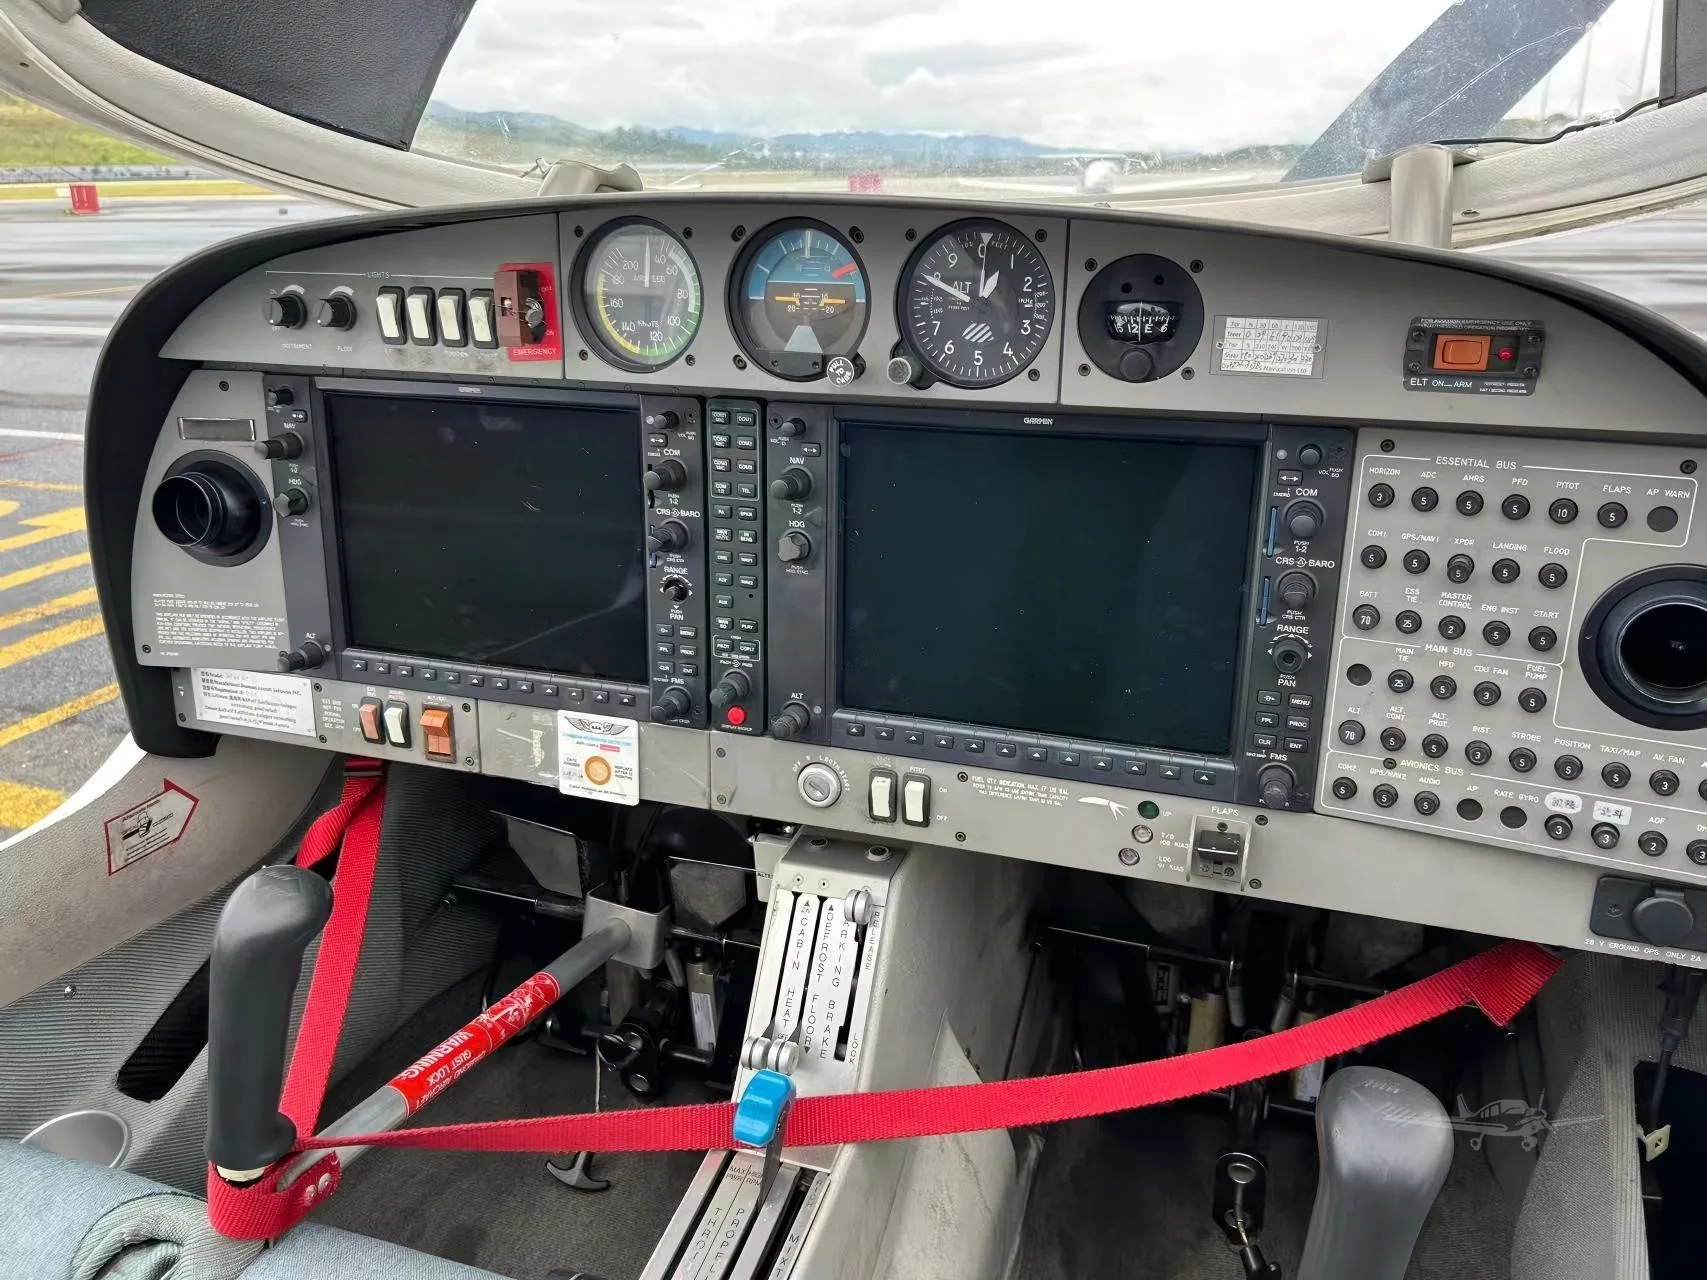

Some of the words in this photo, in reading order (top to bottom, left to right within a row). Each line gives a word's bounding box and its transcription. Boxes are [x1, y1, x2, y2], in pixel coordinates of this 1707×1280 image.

[655, 255, 666, 264] 40
[949, 253, 957, 268] 9
[1010, 254, 1014, 269] 1
[623, 260, 638, 270] 200
[952, 282, 972, 293] ALT
[1023, 276, 1032, 292] 2
[677, 289, 688, 299] 80
[610, 298, 624, 308] 160
[667, 316, 680, 326] 100
[622, 322, 635, 331] 140
[932, 321, 940, 335] 7
[1021, 320, 1031, 335] 3
[1128, 323, 1139, 333] 12
[1145, 324, 1152, 333] E
[650, 331, 663, 341] 120
[945, 340, 954, 354] 6
[1003, 341, 1013, 356] 4
[512, 348, 557, 356] EMERGENCY
[974, 351, 983, 366] 5
[1410, 378, 1428, 386] ELT
[1435, 456, 1490, 468] ESSENTIAL
[1496, 460, 1517, 469] BUS
[1369, 467, 1400, 476] HORIZON
[1512, 478, 1528, 486] PFD
[1556, 481, 1580, 490] PITOT
[1296, 488, 1318, 496] COM
[1603, 485, 1632, 494] FLAPS
[1665, 490, 1690, 498] WARN
[1377, 493, 1383, 501] 3
[1422, 497, 1427, 505] 5
[1466, 501, 1471, 509] 5
[1512, 505, 1518, 513] 5
[1558, 509, 1568, 517] 10
[1609, 513, 1615, 521] 5
[789, 520, 805, 528] HDG
[1493, 542, 1527, 551] LANDING
[1544, 547, 1570, 555] FLOOD
[1275, 557, 1295, 565] CRS
[1369, 554, 1374, 562] 5
[664, 566, 688, 574] RANGE
[1456, 570, 1461, 578] 5
[1503, 569, 1508, 577] 5
[1550, 574, 1555, 582] 5
[1440, 592, 1472, 600] MASTER
[1438, 599, 1472, 609] CONTROL
[1481, 604, 1497, 612] ENG
[1501, 605, 1520, 614] INST
[1534, 610, 1559, 619] START
[1361, 616, 1371, 624] 70
[1277, 624, 1309, 634] RANGE
[1540, 637, 1546, 645] 5
[1425, 644, 1448, 653] MAIN
[1453, 647, 1473, 656] BUS
[1527, 664, 1547, 673] FUEL
[1525, 672, 1547, 680] PUMP
[1278, 679, 1296, 687] PAN
[1530, 699, 1535, 707] 5
[1346, 731, 1355, 740] 70
[1511, 732, 1541, 742] STROBE
[1390, 738, 1394, 746] 5
[1554, 738, 1591, 750] POSITION
[1431, 745, 1436, 753] 5
[1600, 745, 1641, 757] TAXI/MAP
[1270, 753, 1287, 761] FMS
[1668, 755, 1685, 765] FAN
[1400, 759, 1439, 772] AVIONICS
[1445, 766, 1464, 776] BUS
[1520, 759, 1525, 767] 5
[1566, 766, 1571, 774] 5
[1613, 774, 1619, 782] 5
[1340, 786, 1345, 794] 5
[1662, 782, 1668, 790] 3
[1494, 789, 1514, 799] RATE
[1519, 794, 1539, 803] GYRO
[1423, 802, 1429, 810] 5
[1211, 806, 1239, 816] FLAPS
[1556, 826, 1562, 835] 3
[1603, 834, 1609, 843] 3
[1651, 842, 1656, 850] 2
[1700, 851, 1706, 859] 3
[792, 917, 808, 970] CABIN
[865, 911, 880, 971] RELEASE
[817, 912, 834, 982] DEFROST
[1609, 942, 1640, 952] GROUND
[1644, 947, 1659, 955] OPS
[1666, 951, 1686, 960] ONLY
[1691, 954, 1702, 962] 2A
[783, 987, 796, 1028] HEAT
[804, 994, 820, 1046] FLOOR
[820, 1000, 836, 1059] BRAKE
[849, 1033, 858, 1064] LOCK
[400, 1031, 474, 1080] WARNING
[451, 1048, 472, 1070] GUST
[427, 1064, 450, 1087] LOCK
[729, 1166, 746, 1175] MAX
